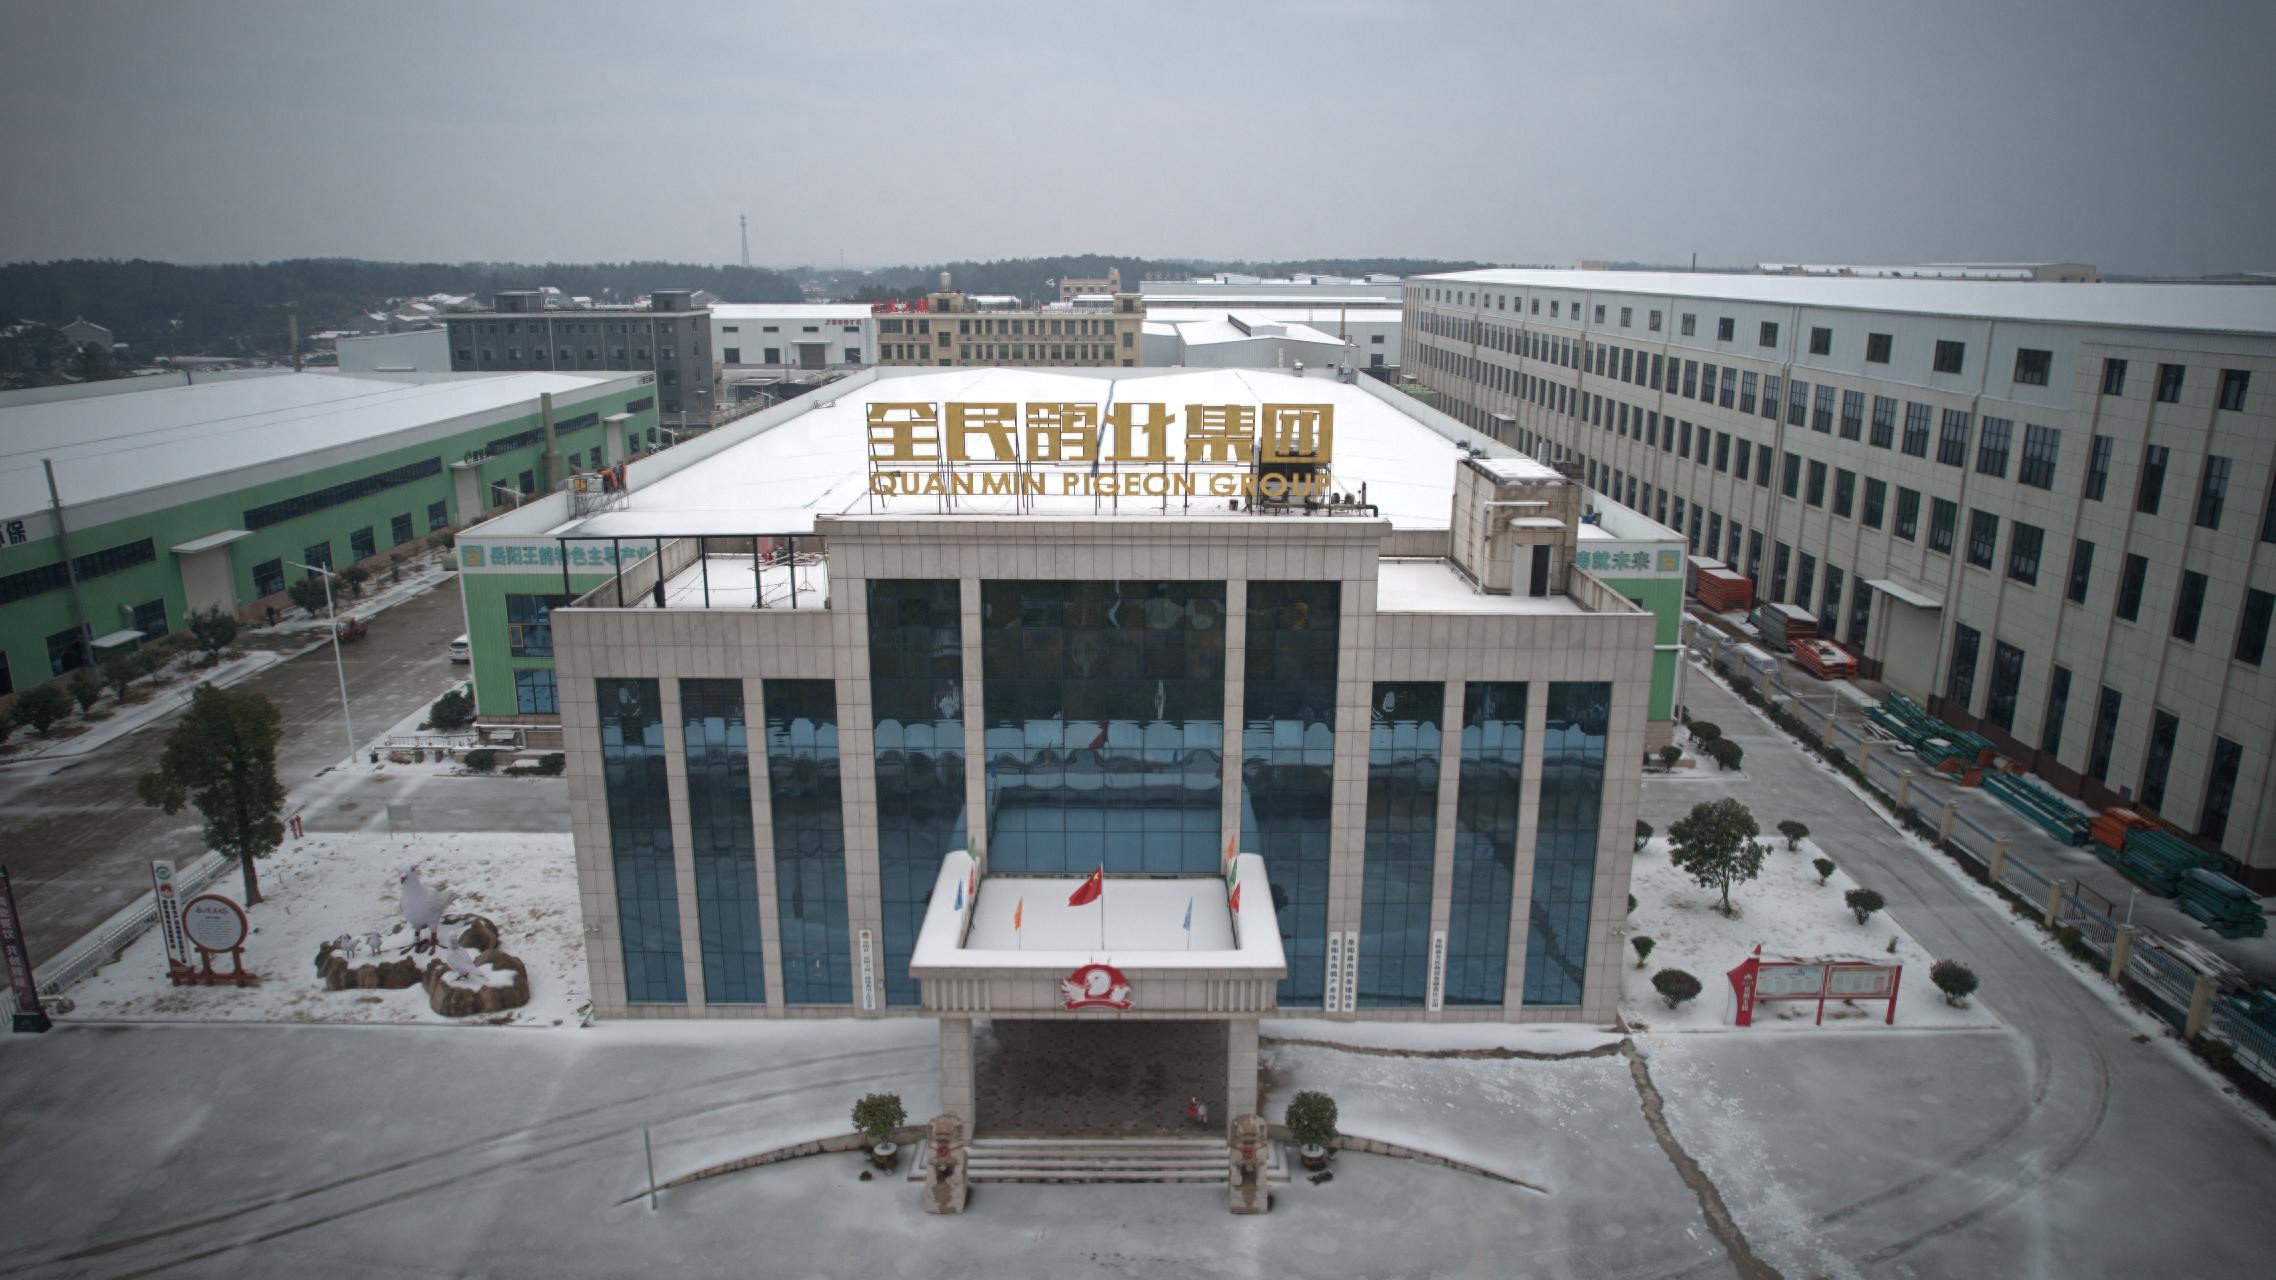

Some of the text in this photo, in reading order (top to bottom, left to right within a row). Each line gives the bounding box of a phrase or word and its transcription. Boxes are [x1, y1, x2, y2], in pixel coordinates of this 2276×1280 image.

[867, 402, 1334, 464] 全民鸽业集团
[869, 472, 1332, 497] QUANMIN PIGEON GROUP
[0, 520, 27, 548] 保
